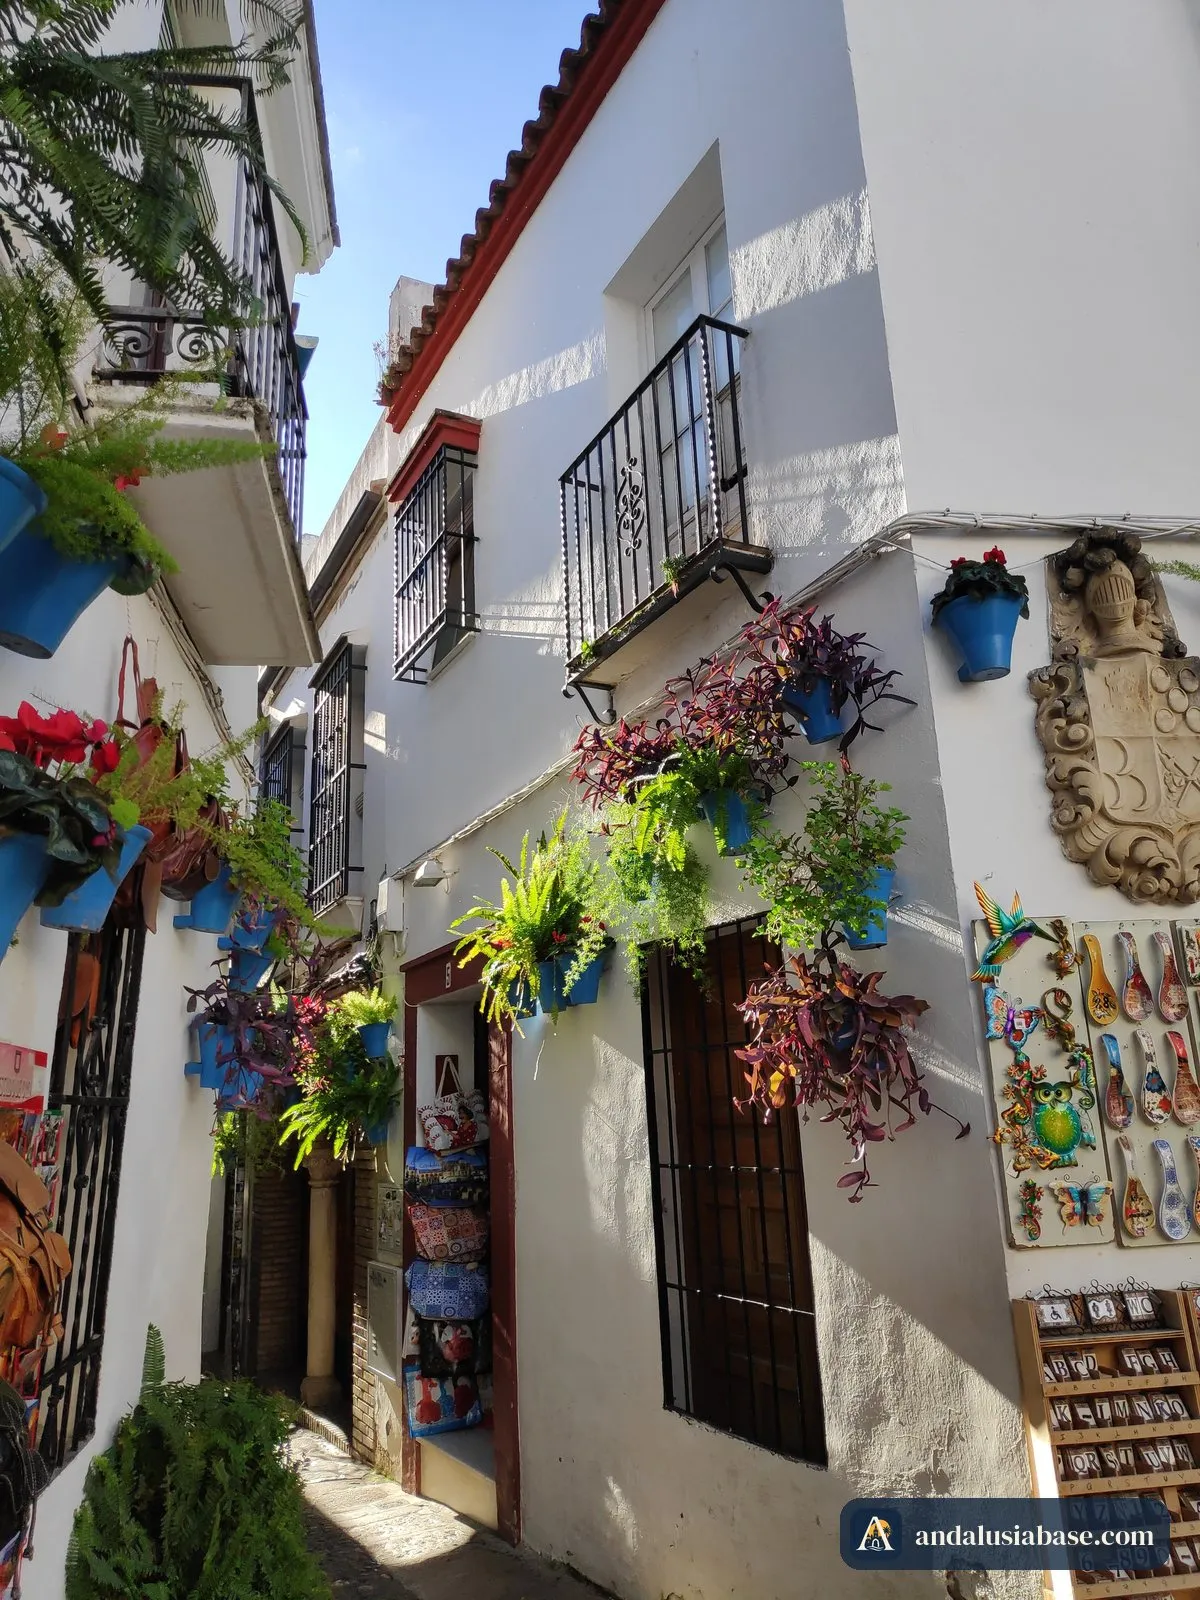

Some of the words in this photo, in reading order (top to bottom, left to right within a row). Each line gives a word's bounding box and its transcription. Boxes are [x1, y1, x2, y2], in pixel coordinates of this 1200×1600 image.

[1126, 1297, 1155, 1313] WC
[1053, 1361, 1068, 1376] B
[1074, 1362, 1089, 1376] C
[1085, 1355, 1096, 1370] D
[1142, 1355, 1157, 1369] G
[1161, 1353, 1177, 1369] H
[1057, 1405, 1071, 1422] K
[1136, 1402, 1152, 1419] N
[1073, 1455, 1088, 1473] Q
[1084, 1452, 1101, 1470] R
[1106, 1453, 1117, 1469] S
[1119, 1448, 1132, 1466] T
[1144, 1452, 1160, 1468] U
[1159, 1446, 1171, 1463] V
[1175, 1445, 1190, 1463] W
